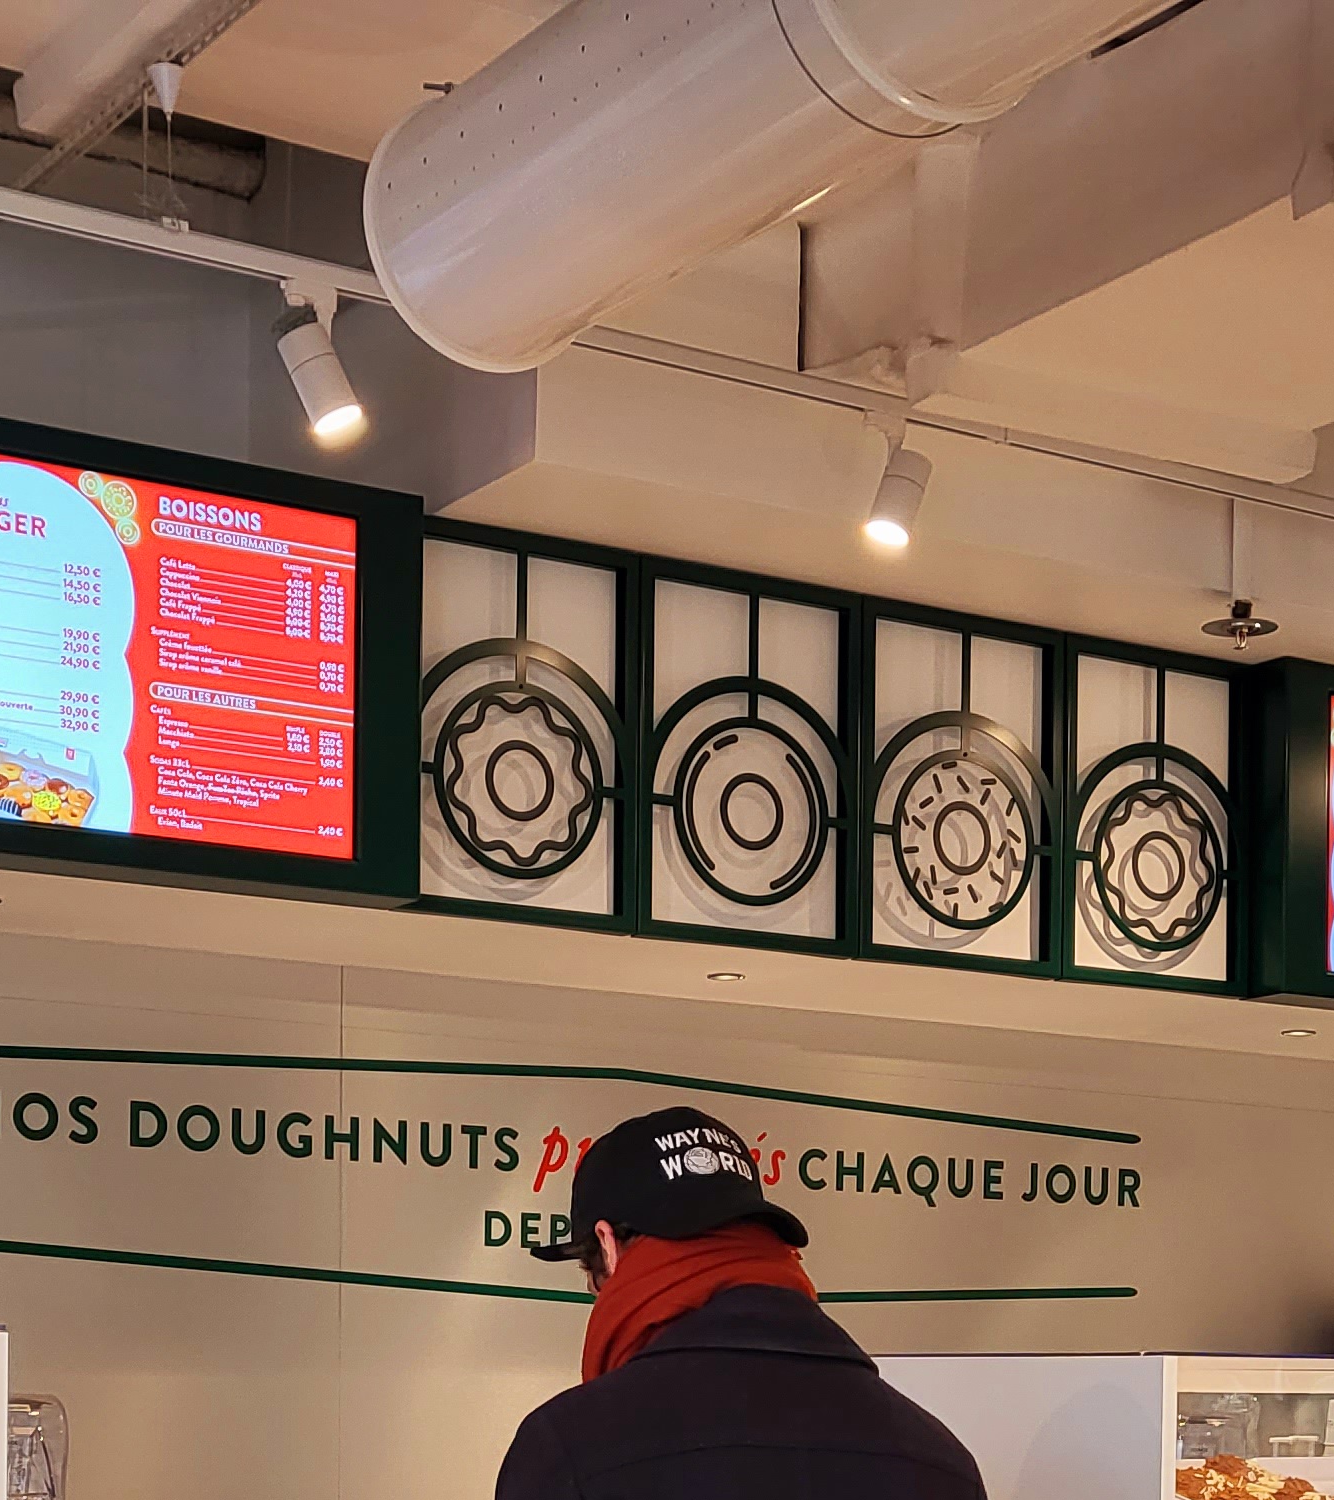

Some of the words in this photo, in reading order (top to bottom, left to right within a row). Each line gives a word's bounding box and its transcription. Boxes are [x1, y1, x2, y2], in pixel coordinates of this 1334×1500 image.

[158, 496, 261, 532] BOISSONS
[159, 522, 192, 538] POUR
[194, 528, 213, 541] LES
[215, 532, 289, 554] GOURMANDS
[64, 564, 89, 577] 12,50
[92, 568, 101, 578] €
[63, 578, 90, 592] 14,50
[92, 583, 101, 594] €
[63, 592, 90, 606] 16,50
[92, 596, 101, 607] €
[63, 628, 89, 642] 19,90
[92, 632, 101, 643] €
[63, 642, 89, 656] 21,90
[92, 645, 101, 656] €
[60, 656, 89, 670] 24,90
[92, 660, 101, 671] €
[60, 691, 89, 704] 29,90
[92, 695, 100, 705] €
[157, 685, 190, 700] POUR
[192, 690, 211, 704] LES
[213, 693, 256, 710] AUTRES
[59, 705, 89, 719] 30,90
[92, 710, 100, 720] €
[60, 719, 88, 733] 32,90
[90, 722, 100, 733] €
[129, 1099, 520, 1172] DOUGHNUTS
[798, 1149, 1005, 1208] CHAQUE
[1020, 1162, 1141, 1208] JOUR
